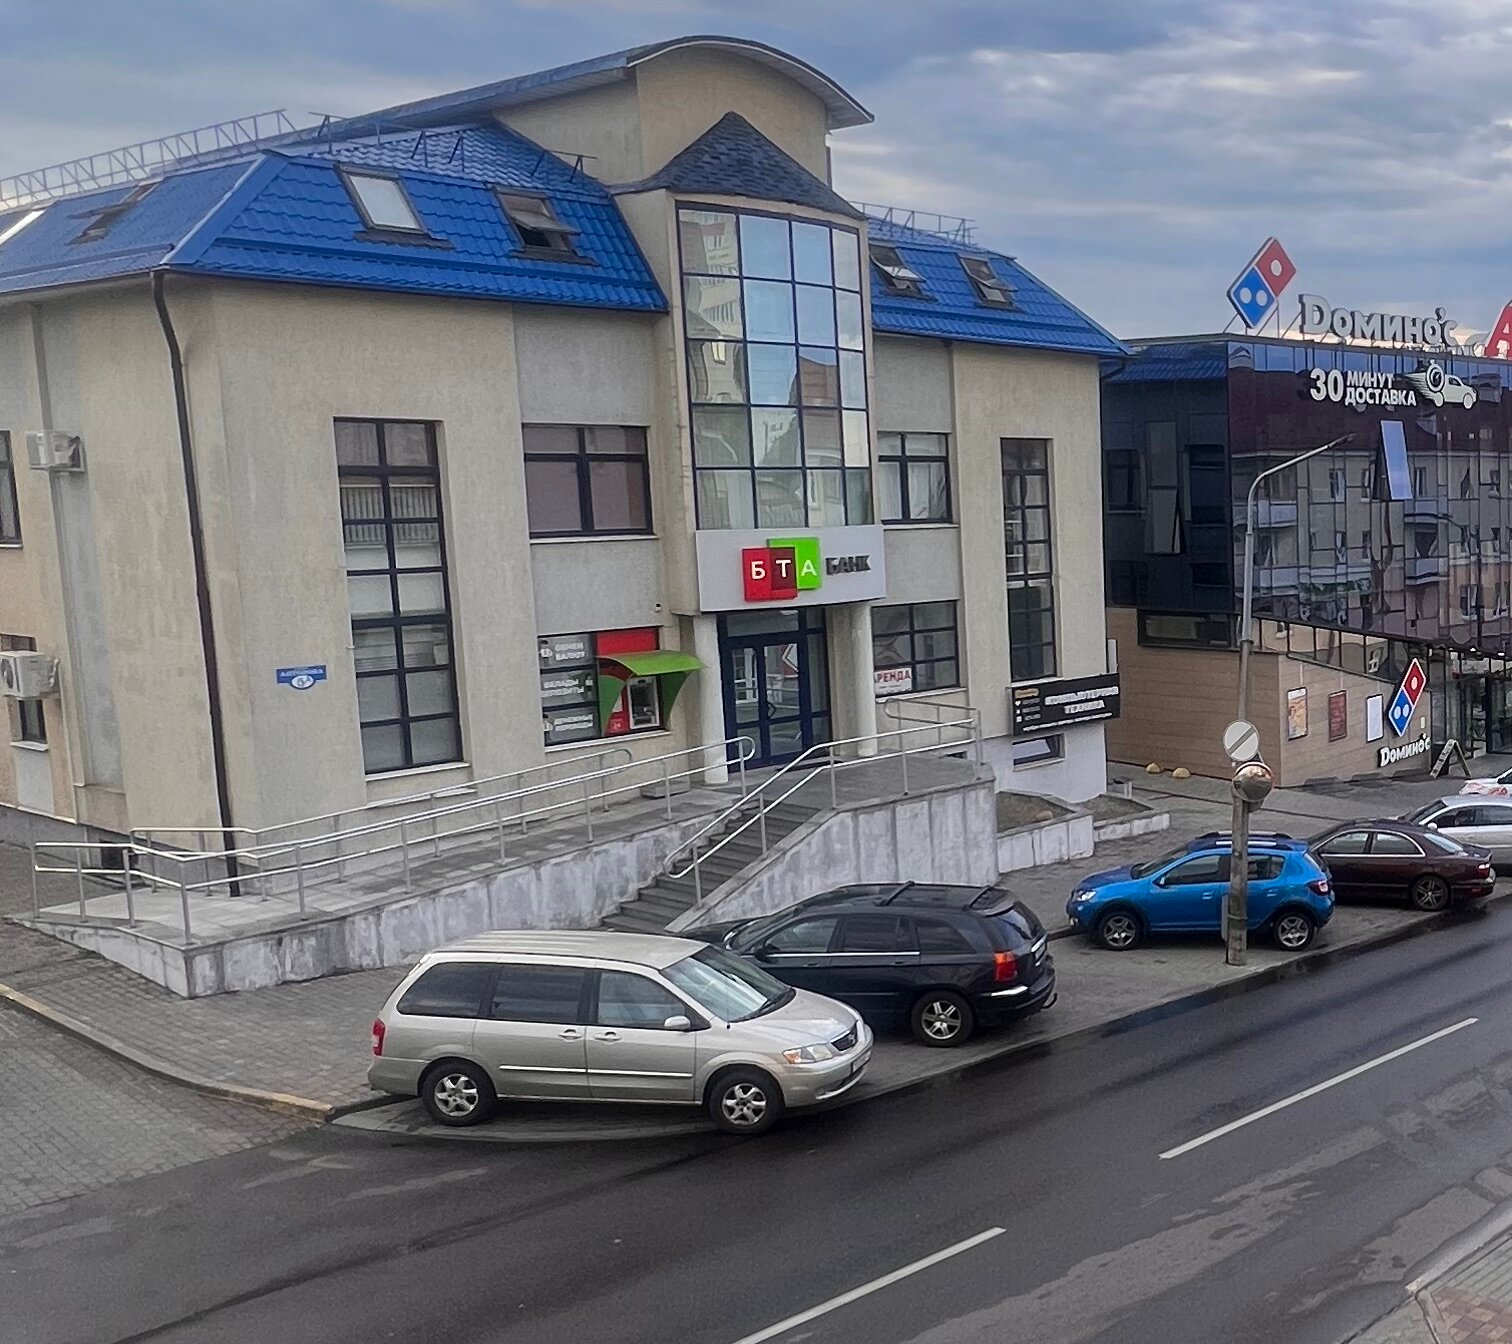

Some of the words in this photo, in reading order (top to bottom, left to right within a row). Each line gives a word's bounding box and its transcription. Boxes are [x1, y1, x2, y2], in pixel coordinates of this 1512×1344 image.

[1310, 368, 1344, 402] 30
[1346, 370, 1394, 389] МИНУТ
[1345, 387, 1417, 406] ДОСТАВКА
[751, 559, 818, 579] БТА
